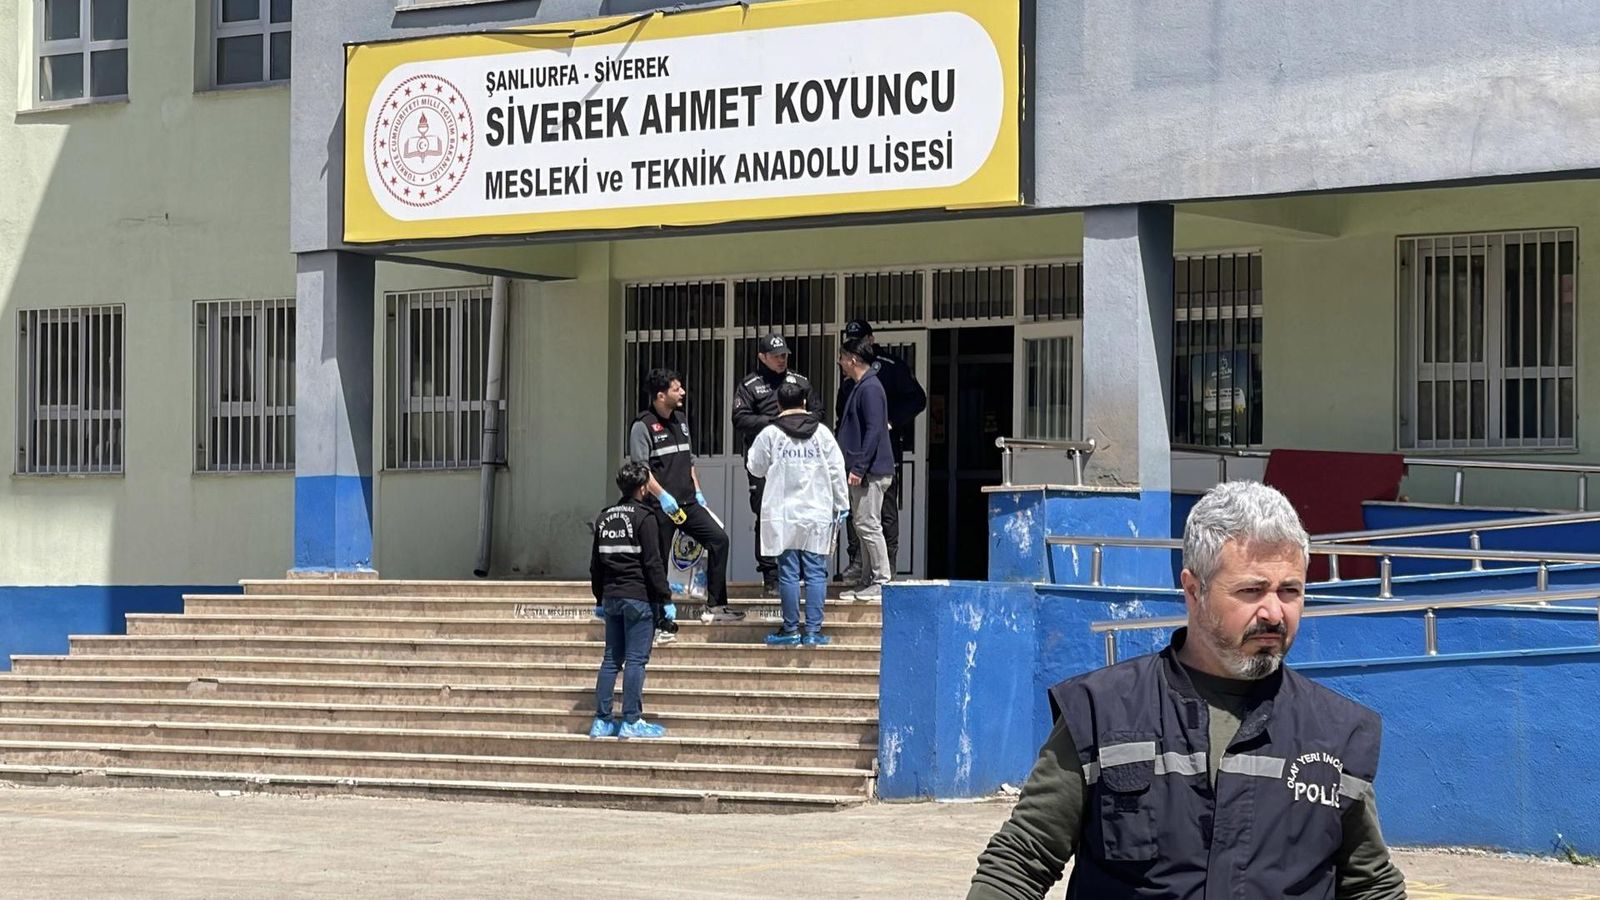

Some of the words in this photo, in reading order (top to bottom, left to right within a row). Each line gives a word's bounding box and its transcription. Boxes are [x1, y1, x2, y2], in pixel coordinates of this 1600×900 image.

[486, 64, 579, 97] ŞANLIURFA
[594, 56, 670, 83] SİVEREK
[485, 96, 629, 147] SİVEREK
[639, 85, 762, 136] AHMET
[775, 69, 955, 124] KOYUNCU
[485, 158, 588, 200] MESLEKİ
[596, 169, 623, 193] ve
[631, 149, 726, 190] TEKNİK
[734, 145, 858, 183] ANADOLU
[869, 131, 952, 174] LİSESİ
[1287, 763, 1300, 789] OLAY
